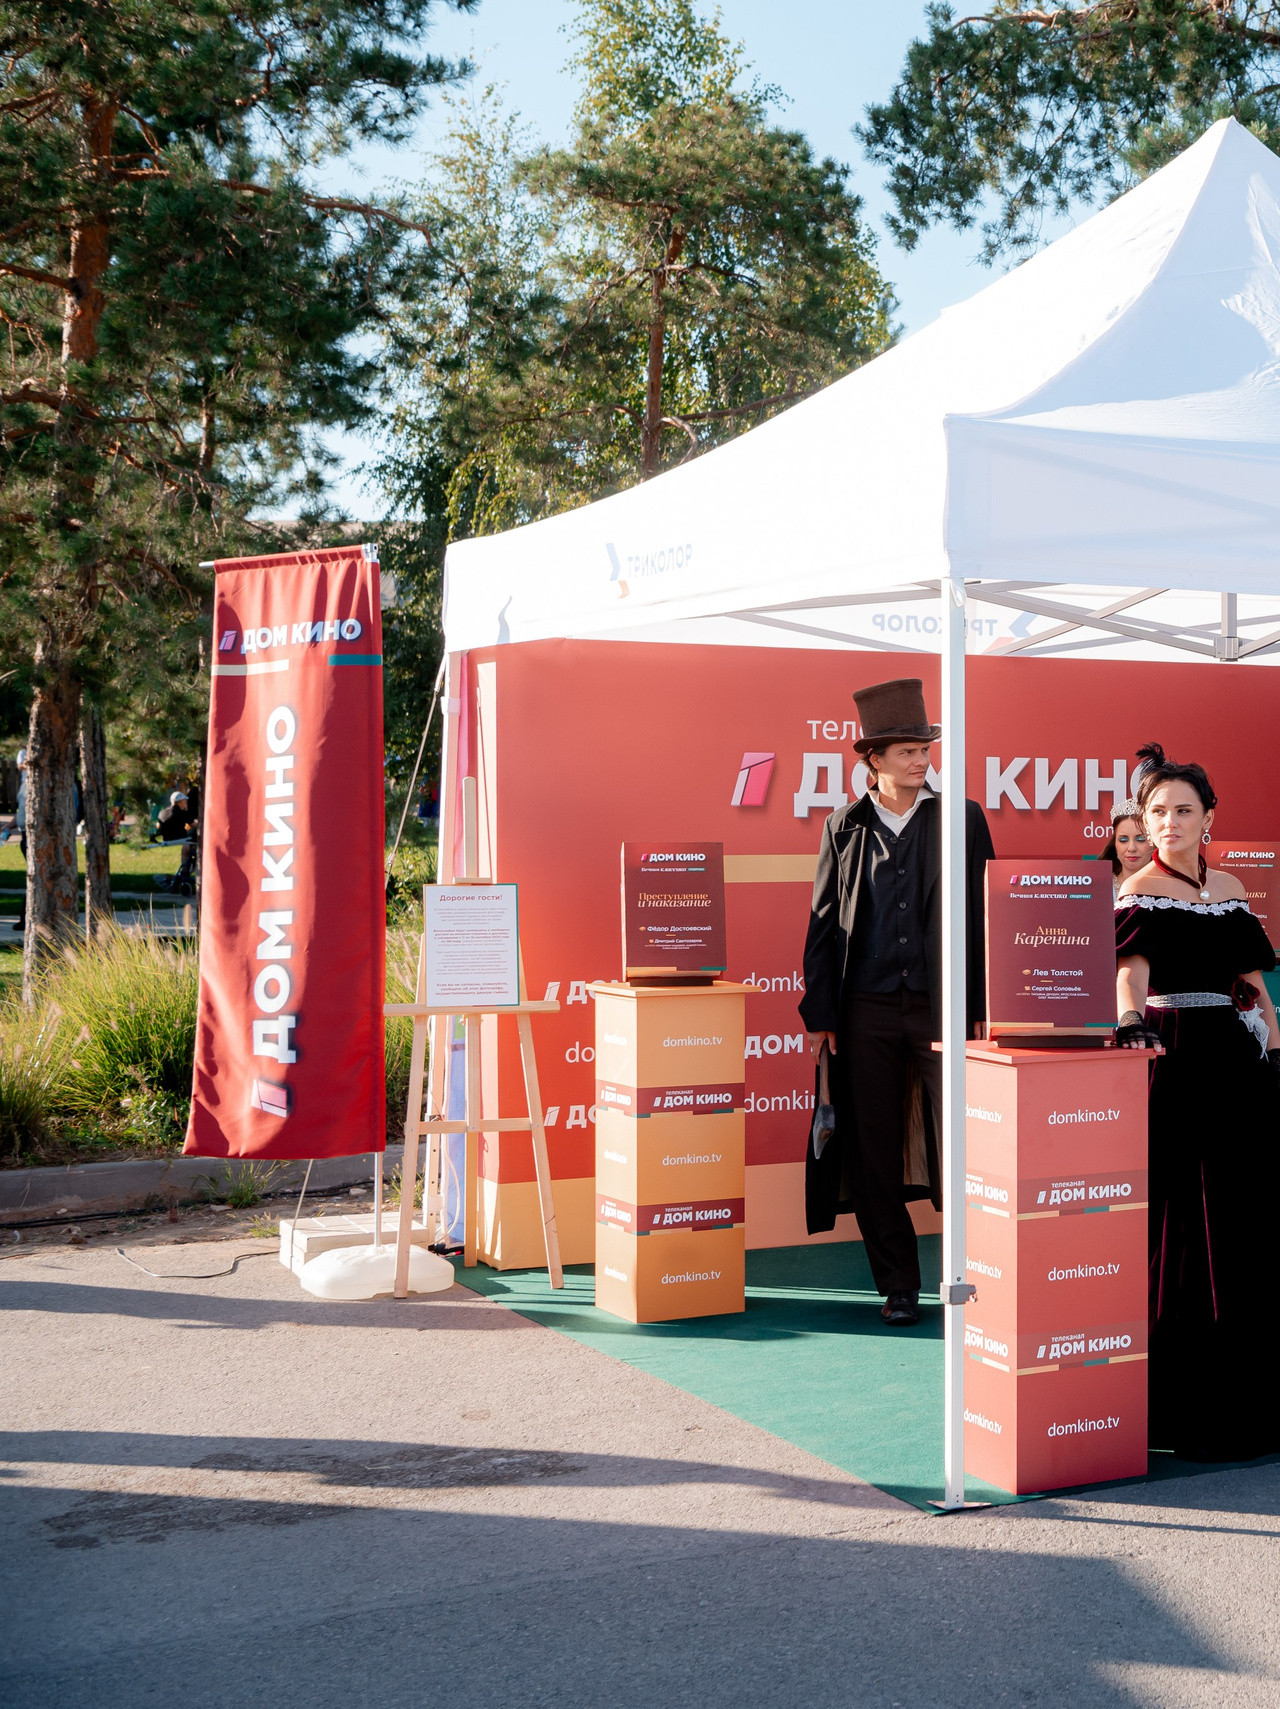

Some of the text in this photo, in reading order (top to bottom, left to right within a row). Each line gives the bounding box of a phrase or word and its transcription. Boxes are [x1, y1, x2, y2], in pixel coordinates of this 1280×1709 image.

[627, 543, 693, 578] ТРИКОЛОР
[240, 618, 362, 655] ДОМ КИНО
[985, 757, 1140, 811] КИН
[649, 853, 706, 862] ДОМ КИНО
[1227, 851, 1276, 859] ДОМ КИНО
[252, 705, 297, 1064] ДОМ КИНО
[1020, 875, 1093, 886] ДОМ КИНО
[440, 894, 476, 902] Дорогие
[637, 899, 712, 908] и наказание
[639, 892, 709, 902] Преступление
[1035, 925, 1068, 936] Анна
[1013, 932, 1091, 948] Каренина
[1032, 968, 1084, 976] Лев Толстой
[662, 1035, 723, 1048] domkino.tv
[744, 1033, 804, 1060] ДОМ
[663, 1093, 733, 1108] ДОМ КИНО
[1047, 1108, 1121, 1125] domkino.tv
[661, 1153, 722, 1166] domkino.tv
[965, 1180, 1009, 1203] ДОМ КИНО
[1051, 1180, 1085, 1189] телеканал
[1049, 1183, 1132, 1205] ДОМ КИНО
[662, 1208, 732, 1226] ДОМ КИНО
[661, 1270, 722, 1285] domkino.tv
[1047, 1262, 1121, 1281] domkino.tv
[964, 1330, 1009, 1358] ДОМ КИНО
[1051, 1333, 1085, 1342] телеканал
[1048, 1334, 1132, 1360] ДОМ КИНО
[963, 1407, 1002, 1435] domkino.tv
[1047, 1415, 1120, 1437] domkino.tv
